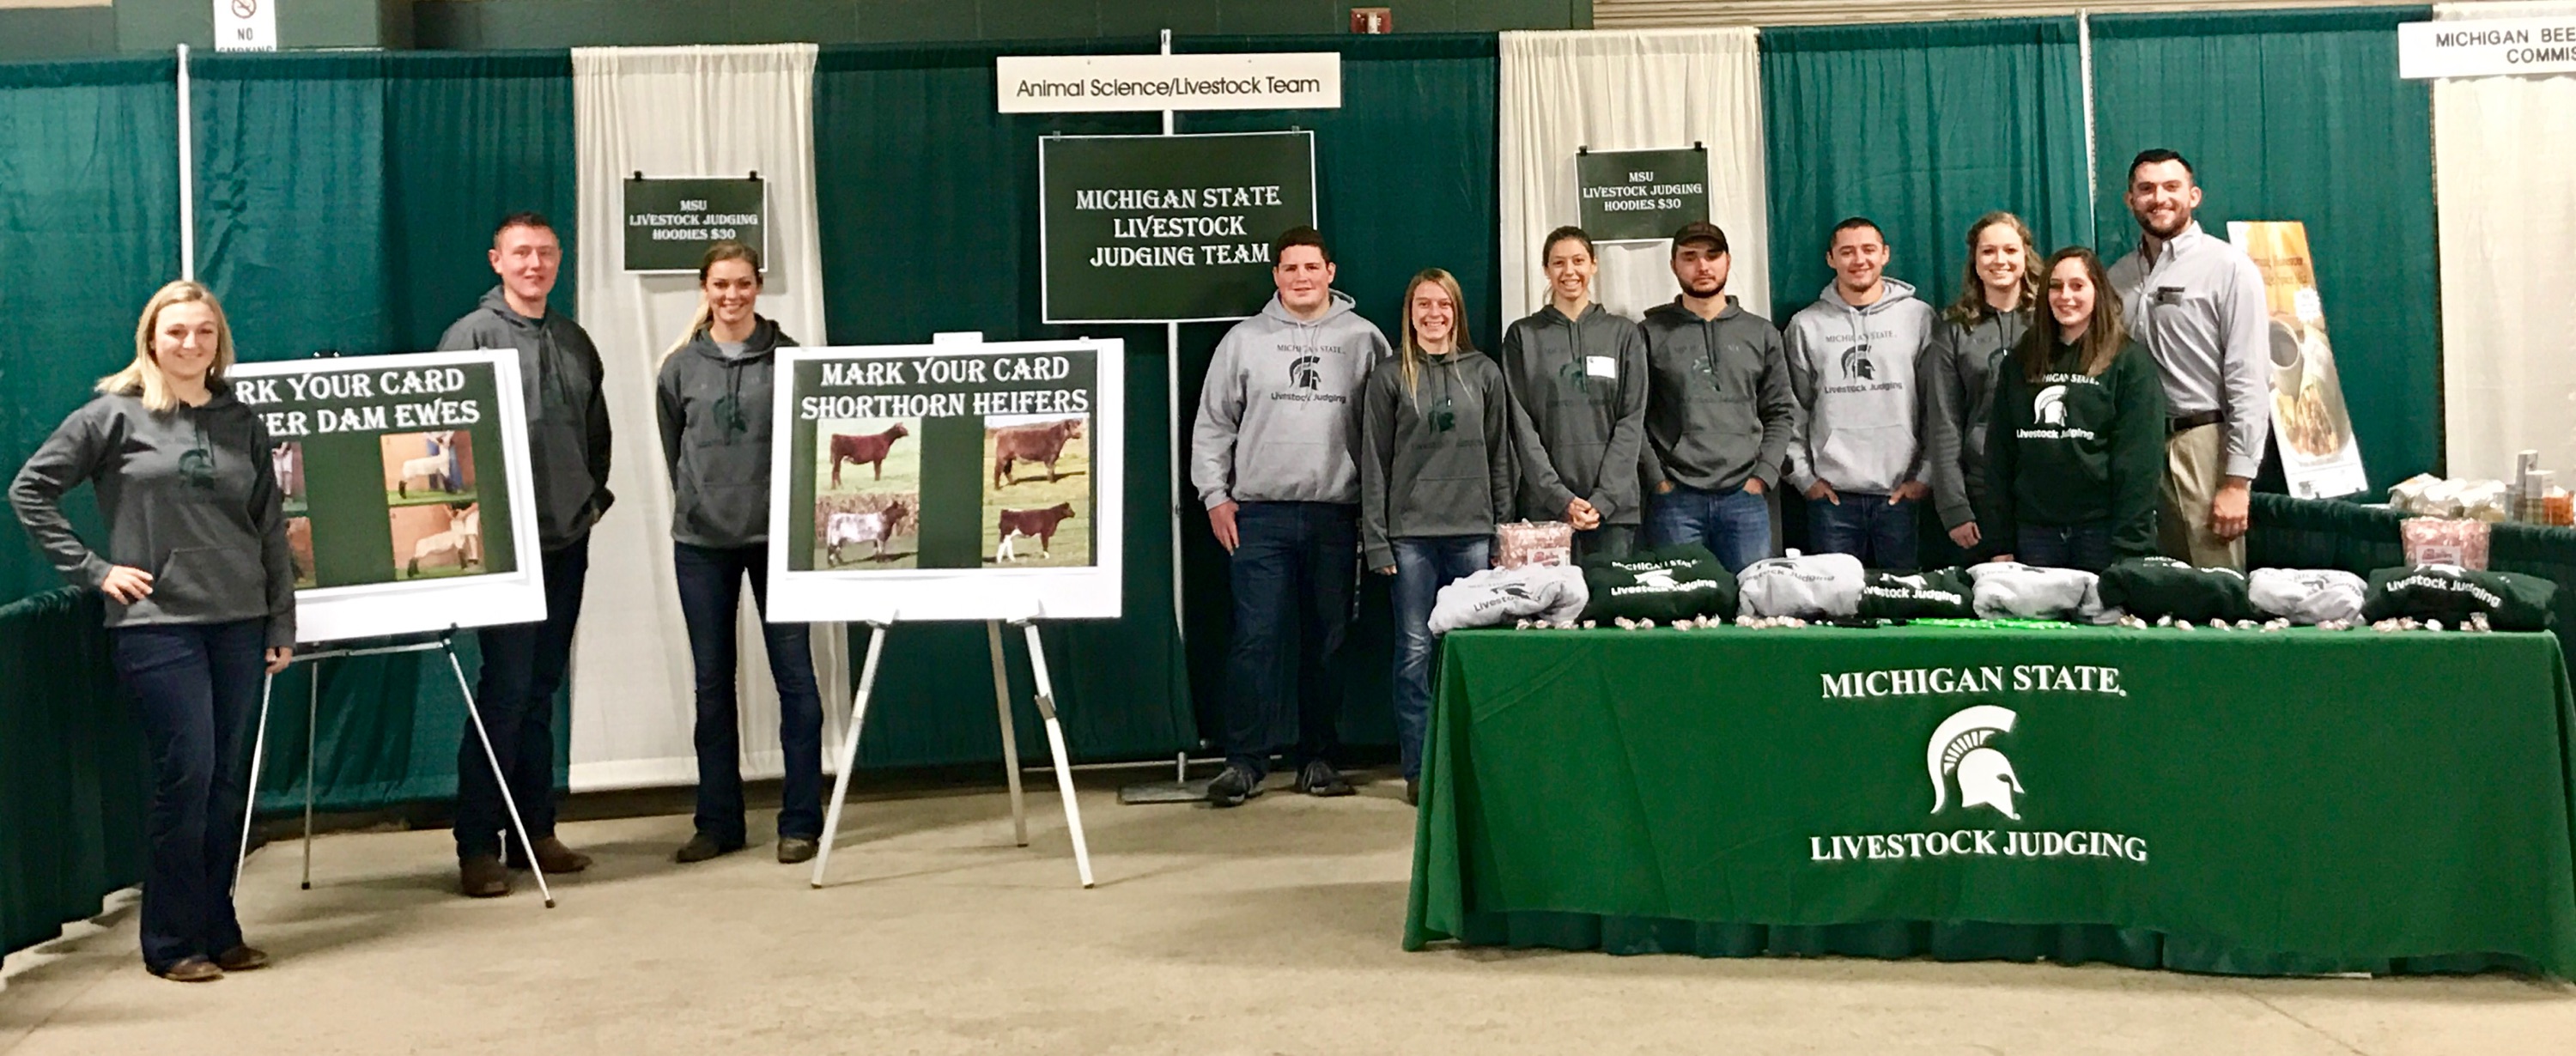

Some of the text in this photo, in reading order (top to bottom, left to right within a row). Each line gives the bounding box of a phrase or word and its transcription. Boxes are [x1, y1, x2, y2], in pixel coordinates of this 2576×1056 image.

[237, 27, 253, 41] NO
[2435, 29, 2530, 47] MICHIGAN
[1017, 76, 1320, 97] Animal Science/Livestock Team
[1629, 172, 1654, 182] MSU
[1075, 185, 1282, 210] MICHIGAN STATE
[1583, 183, 1703, 198] LIVESTOCK JUDGING
[680, 199, 708, 211] MSU
[1604, 198, 1681, 211] HOODIES $30
[629, 213, 758, 226] LIVESTOCK JUDGING
[1113, 215, 1247, 239] LIVESTOCK
[652, 228, 736, 240] HOODIES $30
[1090, 243, 1271, 267] JUDGING TEAM
[820, 355, 1070, 387] MARK YOUR CARD
[235, 367, 465, 405] RK YOUR CARD
[1824, 381, 1903, 394] Livestock Judging
[800, 389, 1089, 420] SHORTHORN HEIFERS
[1313, 393, 1346, 404] Judging
[259, 398, 481, 436] ER DAM EWES
[2016, 428, 2059, 439] Livestock
[1912, 589, 1961, 605] Judging
[2386, 574, 2448, 592] Livestock
[2450, 579, 2502, 609] Judging
[1820, 666, 2003, 699] MICHIGAN
[1809, 829, 2148, 862] LIVESTOCK JUDGING
